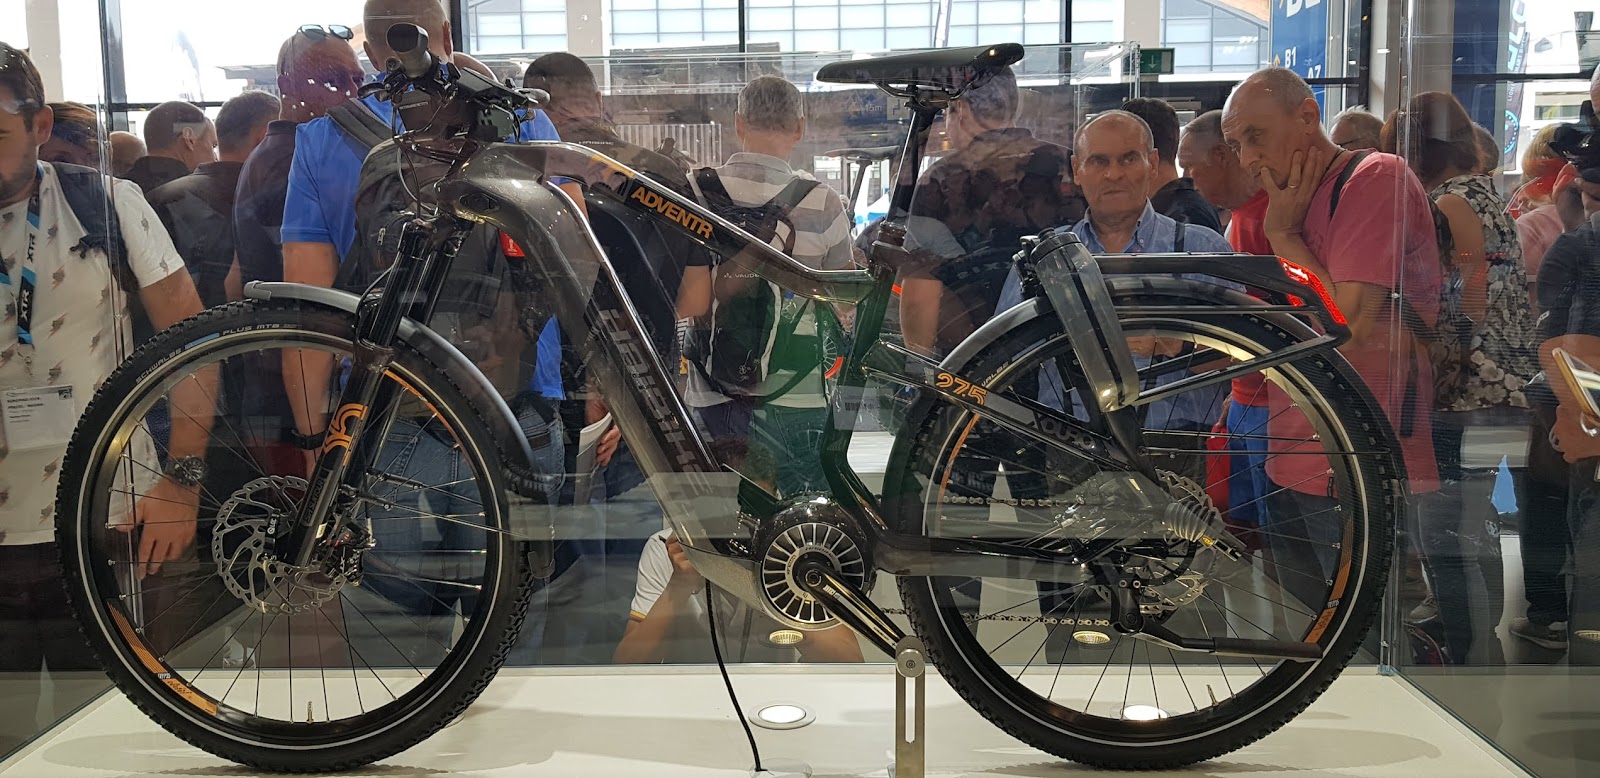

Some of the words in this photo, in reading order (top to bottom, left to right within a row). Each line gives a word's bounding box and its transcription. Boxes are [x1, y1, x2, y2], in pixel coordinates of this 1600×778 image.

[1284, 46, 1297, 69] B1
[630, 186, 714, 239] ADVENTR
[26, 232, 36, 263] XTR
[20, 289, 30, 321] XTR
[222, 325, 253, 336] PLUS
[135, 346, 182, 384] SCHWALBE
[306, 478, 326, 508] SUNTOUR
